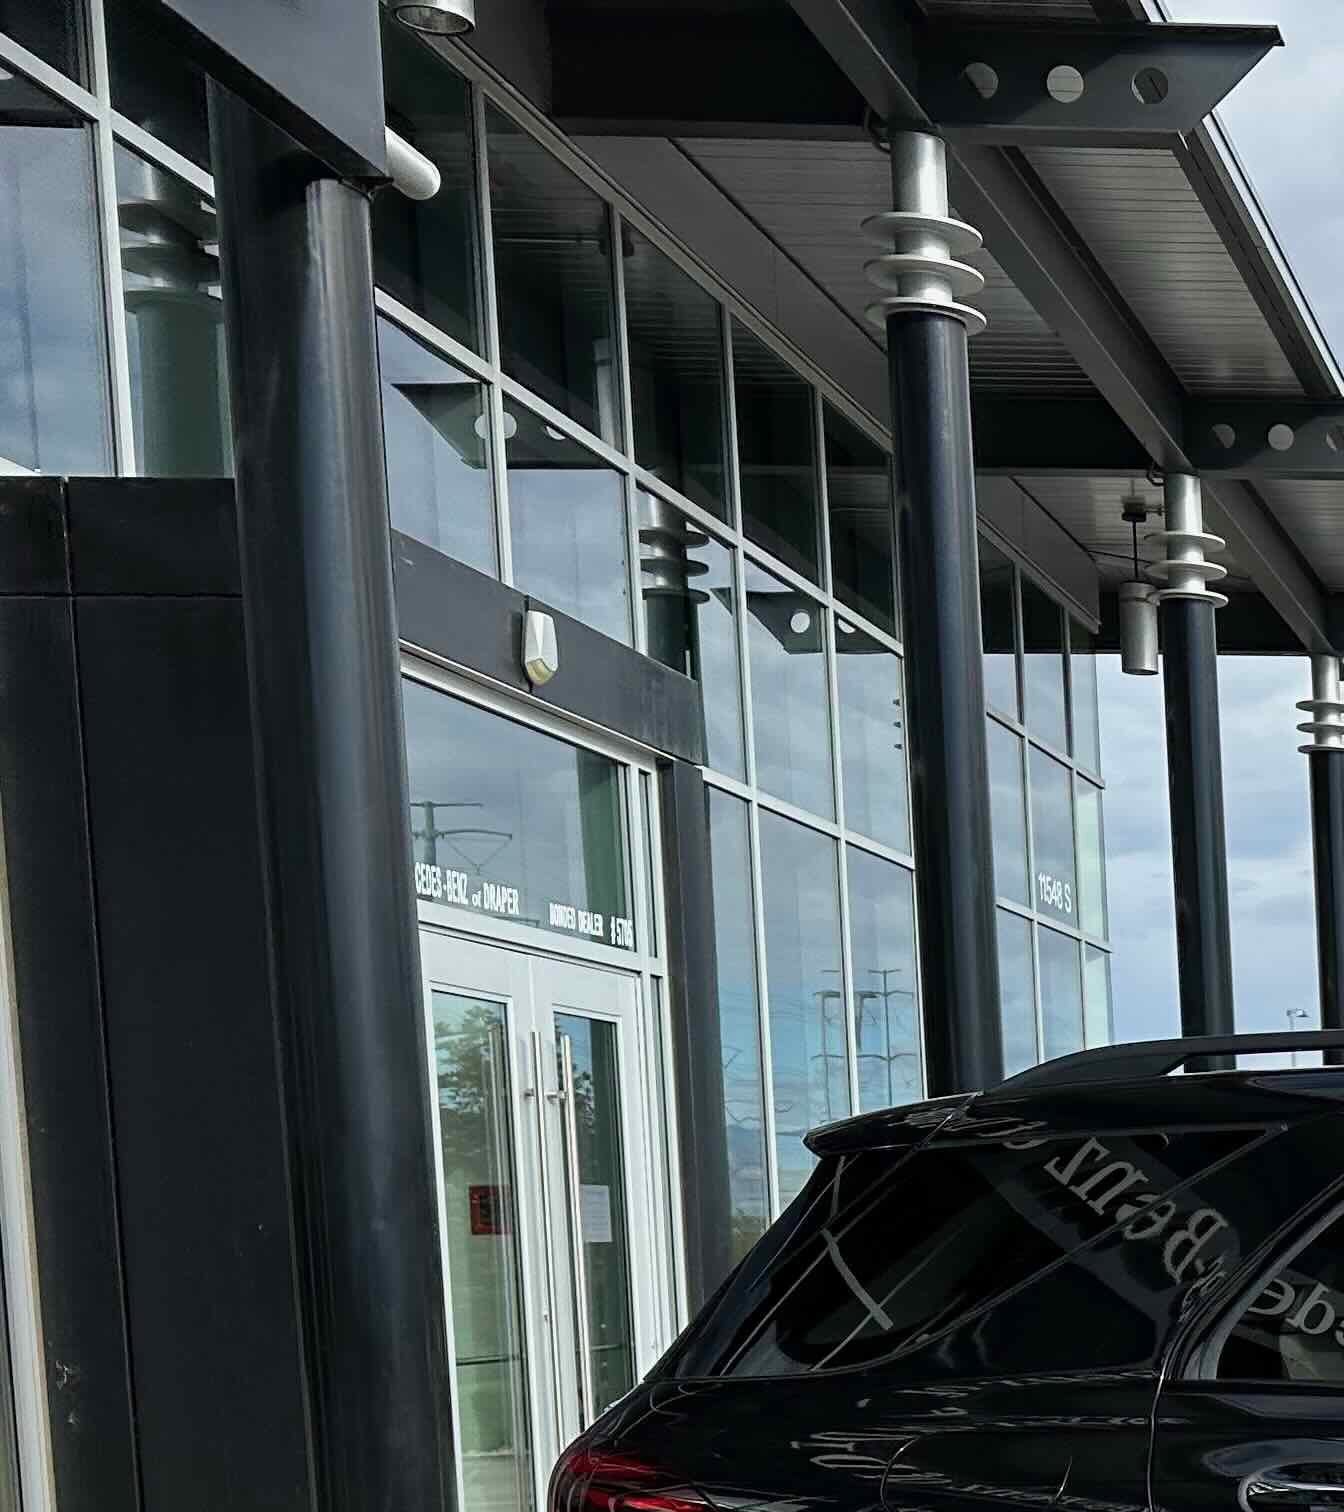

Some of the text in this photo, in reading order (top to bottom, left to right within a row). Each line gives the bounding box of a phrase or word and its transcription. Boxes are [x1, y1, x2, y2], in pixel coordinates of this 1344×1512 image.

[471, 889, 482, 907] of
[483, 882, 520, 915] DRAPER
[1038, 871, 1072, 913] 11548 S
[577, 910, 604, 937] DEALER
